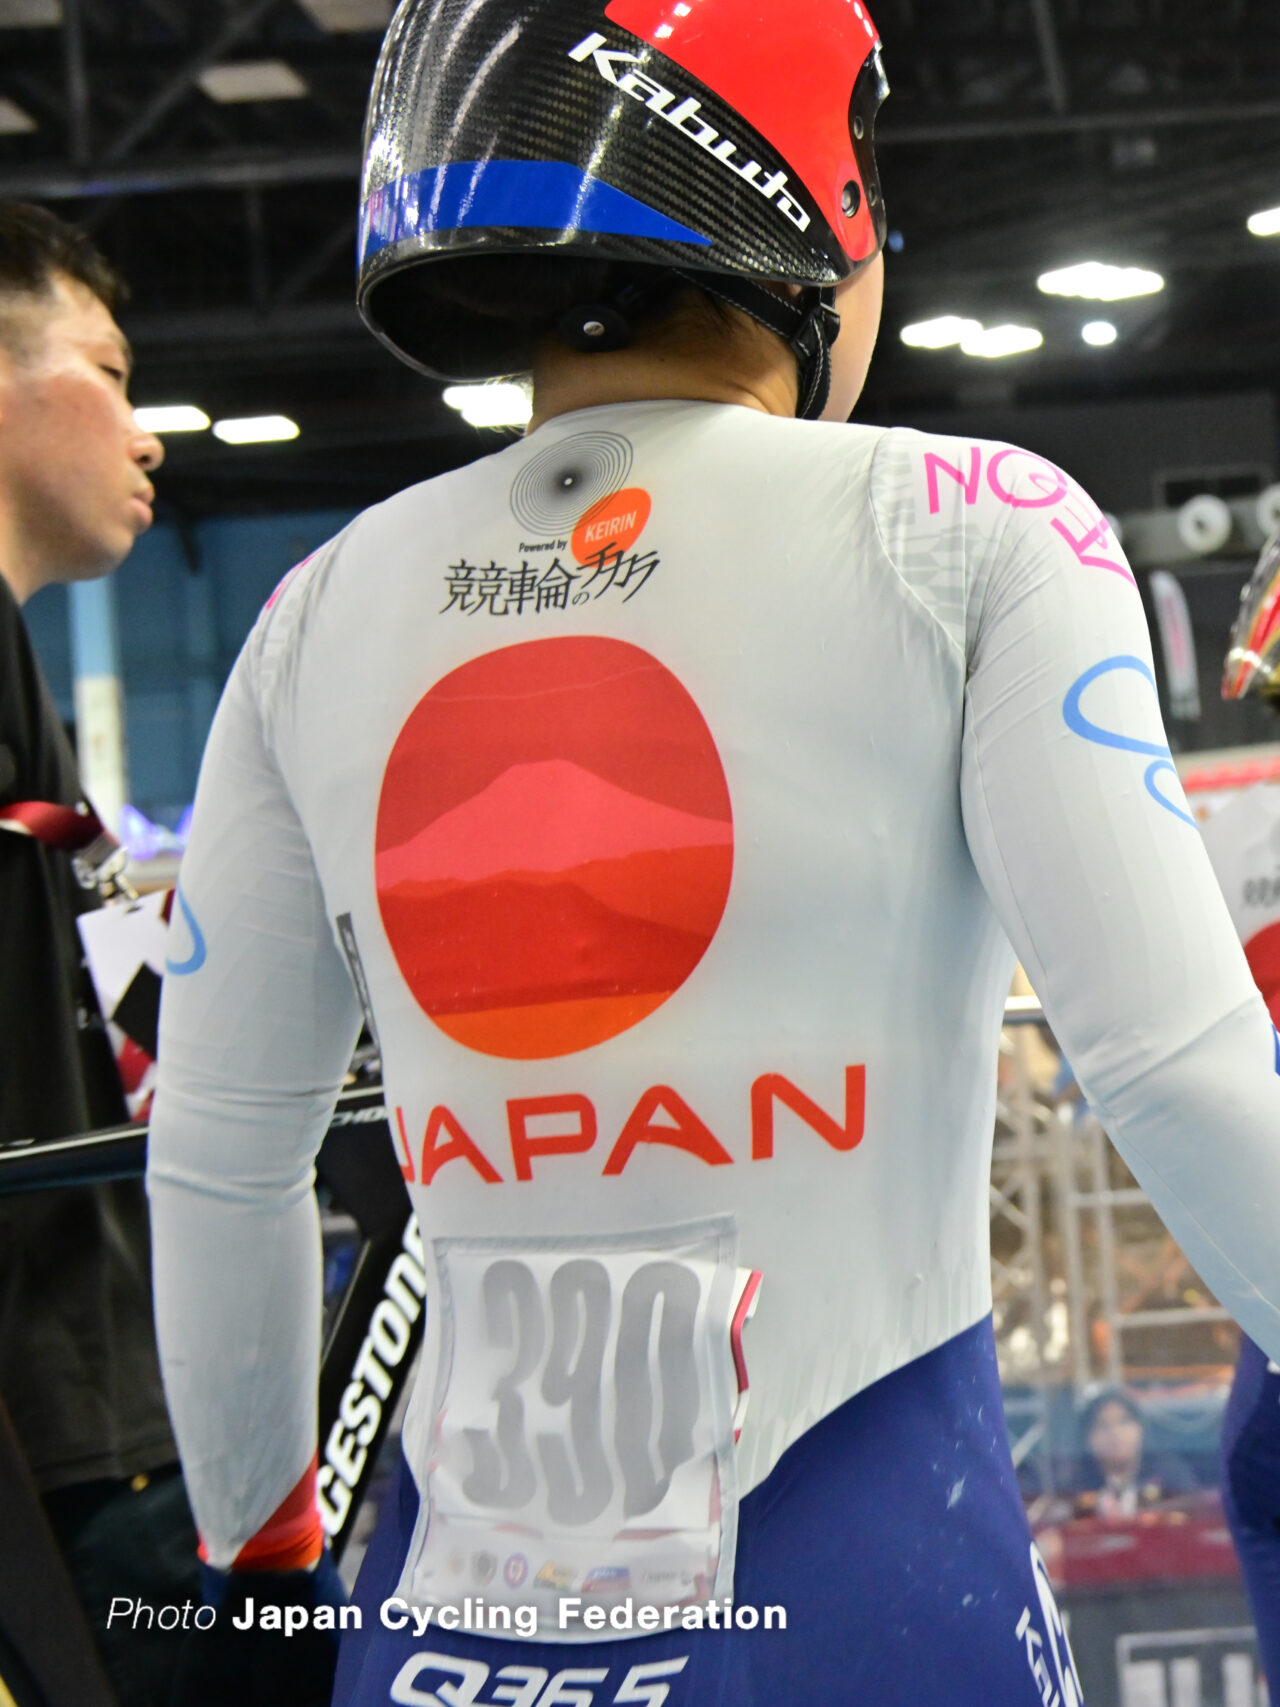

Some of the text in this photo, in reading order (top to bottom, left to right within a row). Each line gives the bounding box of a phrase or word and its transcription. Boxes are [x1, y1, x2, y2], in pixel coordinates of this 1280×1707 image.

[568, 31, 812, 232] Kabuto
[518, 539, 568, 553] Powered by
[584, 510, 638, 544] KEIRIN
[316, 1211, 428, 1537] GESTON
[462, 1257, 702, 1525] 390
[389, 1650, 690, 1707] Q365
